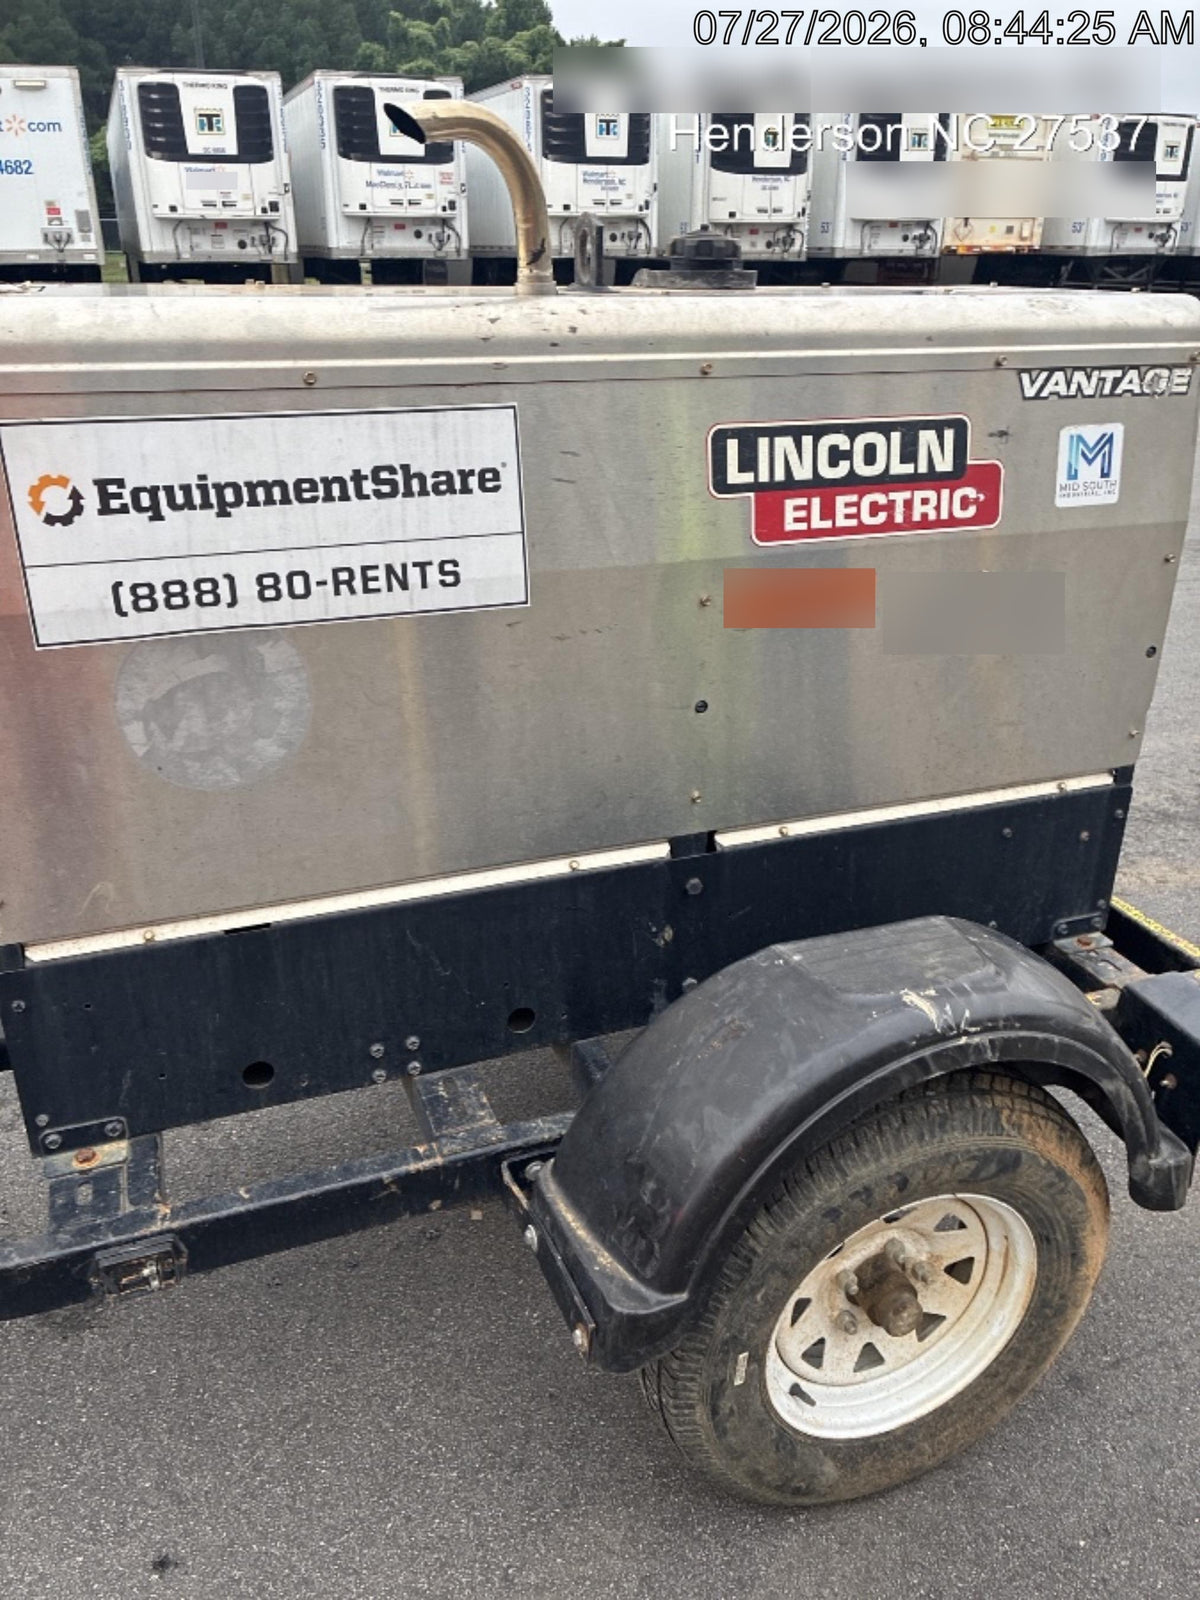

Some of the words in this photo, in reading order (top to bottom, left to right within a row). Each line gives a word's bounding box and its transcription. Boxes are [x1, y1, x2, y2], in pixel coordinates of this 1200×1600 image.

[1019, 367, 1193, 400] VANTAGE
[726, 427, 956, 485] LINCOLN
[93, 462, 502, 522] EquipmentShare
[783, 486, 978, 533] ELECTRIC
[1059, 482, 1080, 492] MID
[1082, 480, 1117, 491] SOUTH
[111, 573, 239, 618] (888)
[255, 558, 462, 603] 80-RENTS
